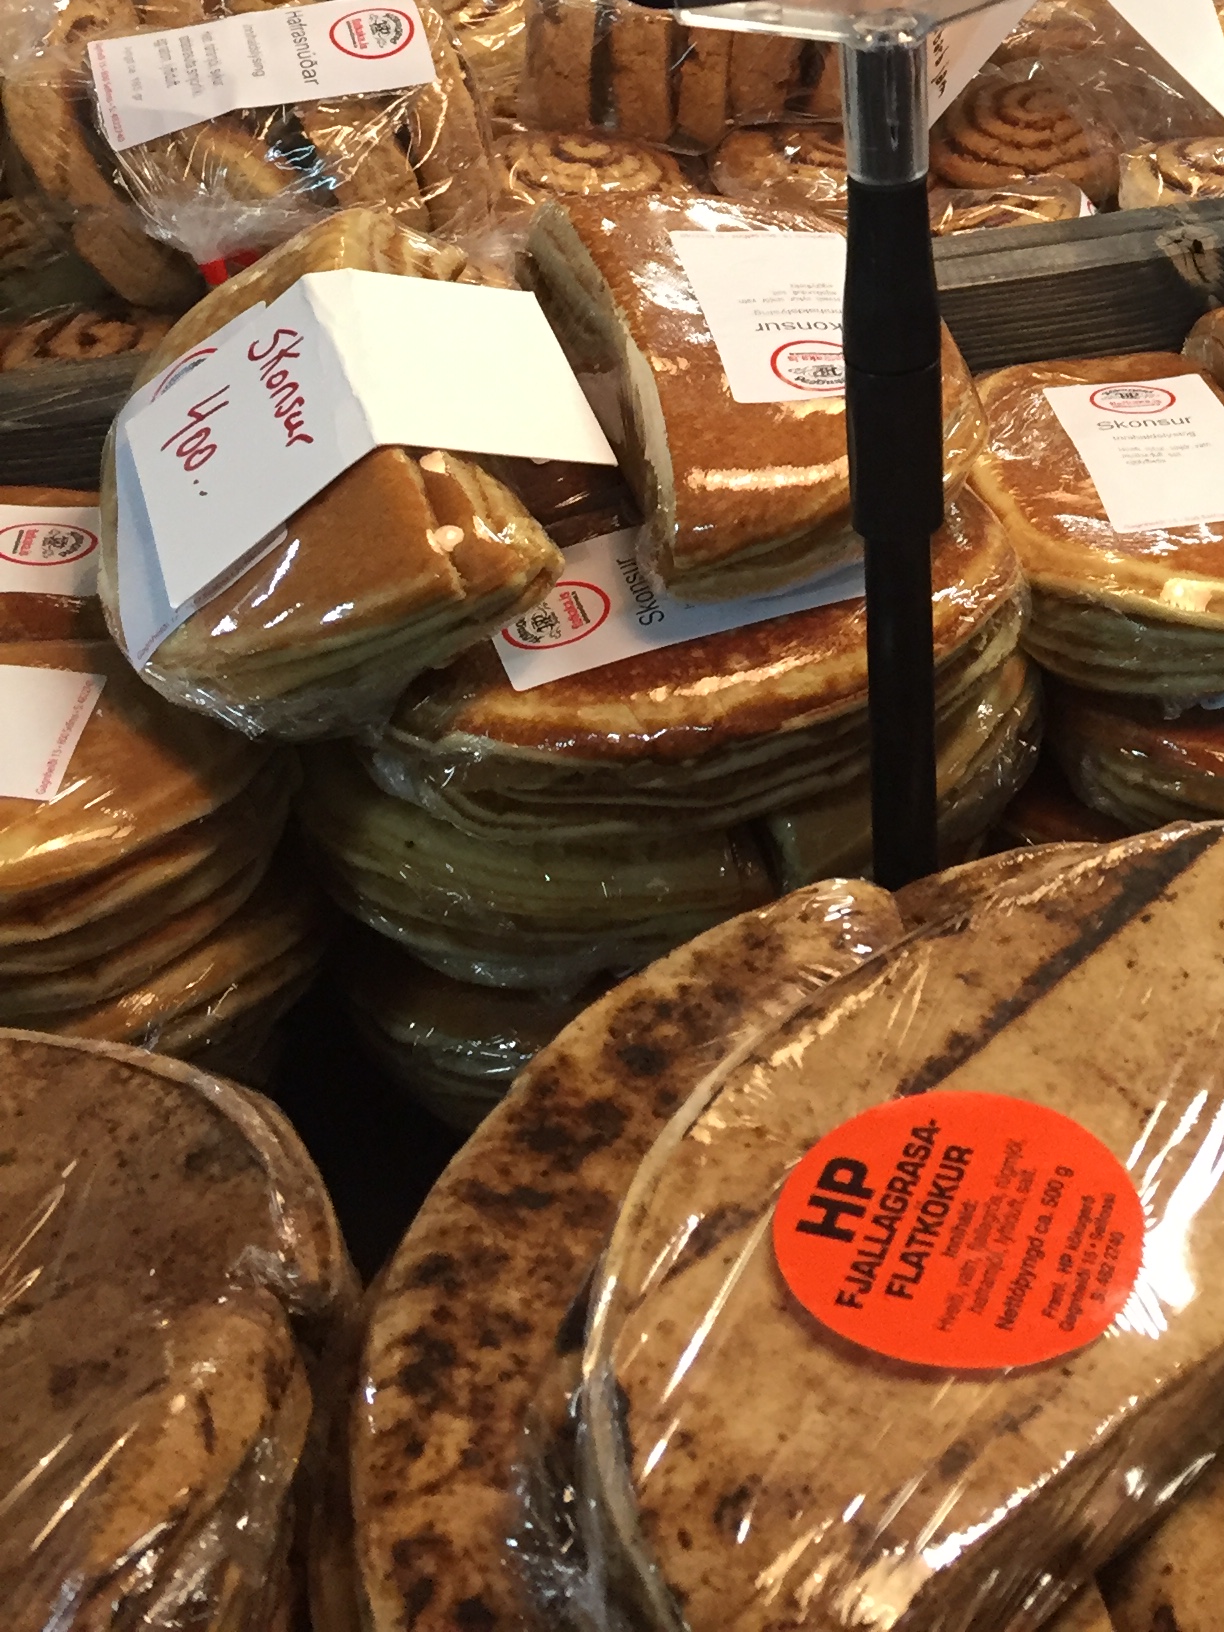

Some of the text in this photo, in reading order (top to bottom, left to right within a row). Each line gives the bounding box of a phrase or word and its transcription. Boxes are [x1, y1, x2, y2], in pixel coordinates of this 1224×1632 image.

[285, 10, 319, 86] Hafrasnúðar
[754, 321, 844, 332] konsur
[247, 328, 314, 448] Skonsur
[1096, 416, 1192, 431] Skonsur
[616, 557, 665, 626] Skonsur
[796, 1156, 875, 1243] HP
[834, 1118, 941, 1310] FJALLAGRASA-
[885, 1145, 974, 1300] FLATKÖKUR
[1040, 1179, 1064, 1209] 500
